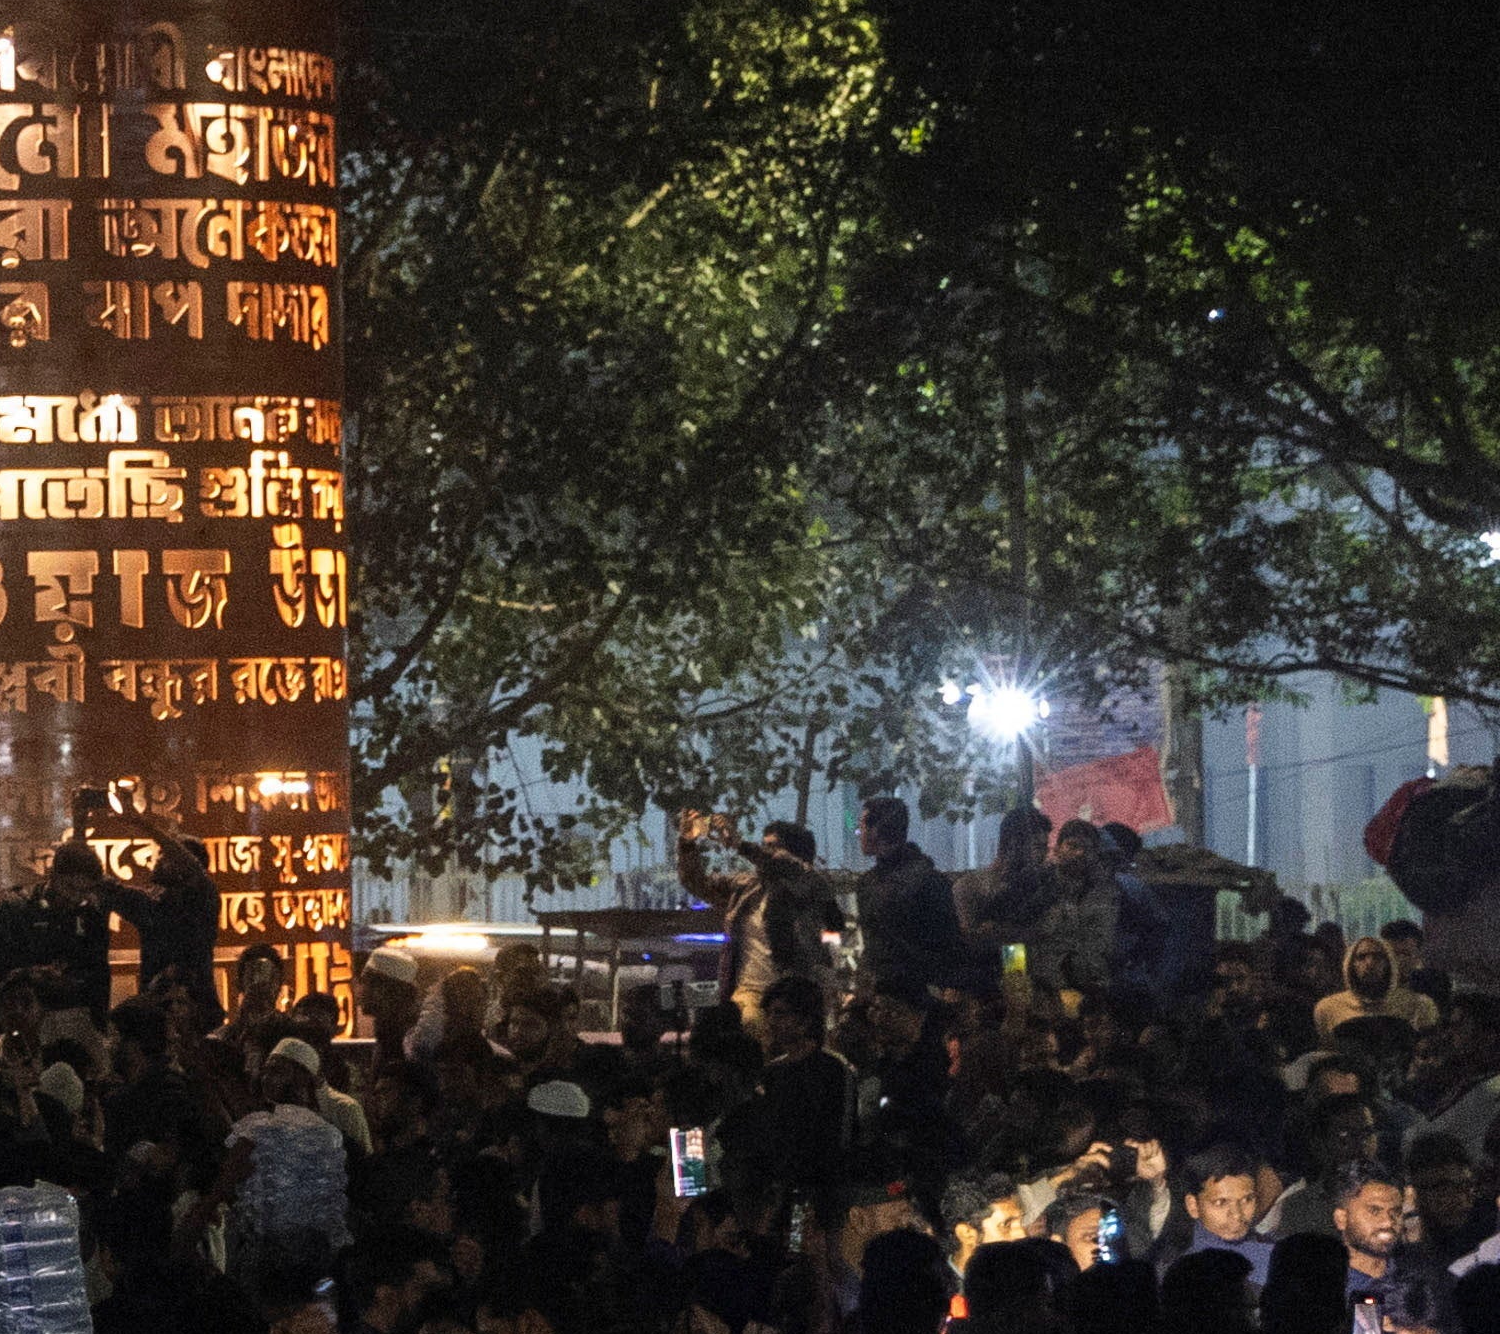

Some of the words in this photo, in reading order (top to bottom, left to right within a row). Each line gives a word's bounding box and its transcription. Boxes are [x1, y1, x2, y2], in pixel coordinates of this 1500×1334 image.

[81, 281, 203, 341] বাপ
[227, 281, 330, 350] দাদার
[200, 450, 303, 520] গুলি
[103, 658, 219, 722] বন্ধুর
[230, 657, 306, 704] রক্তে
